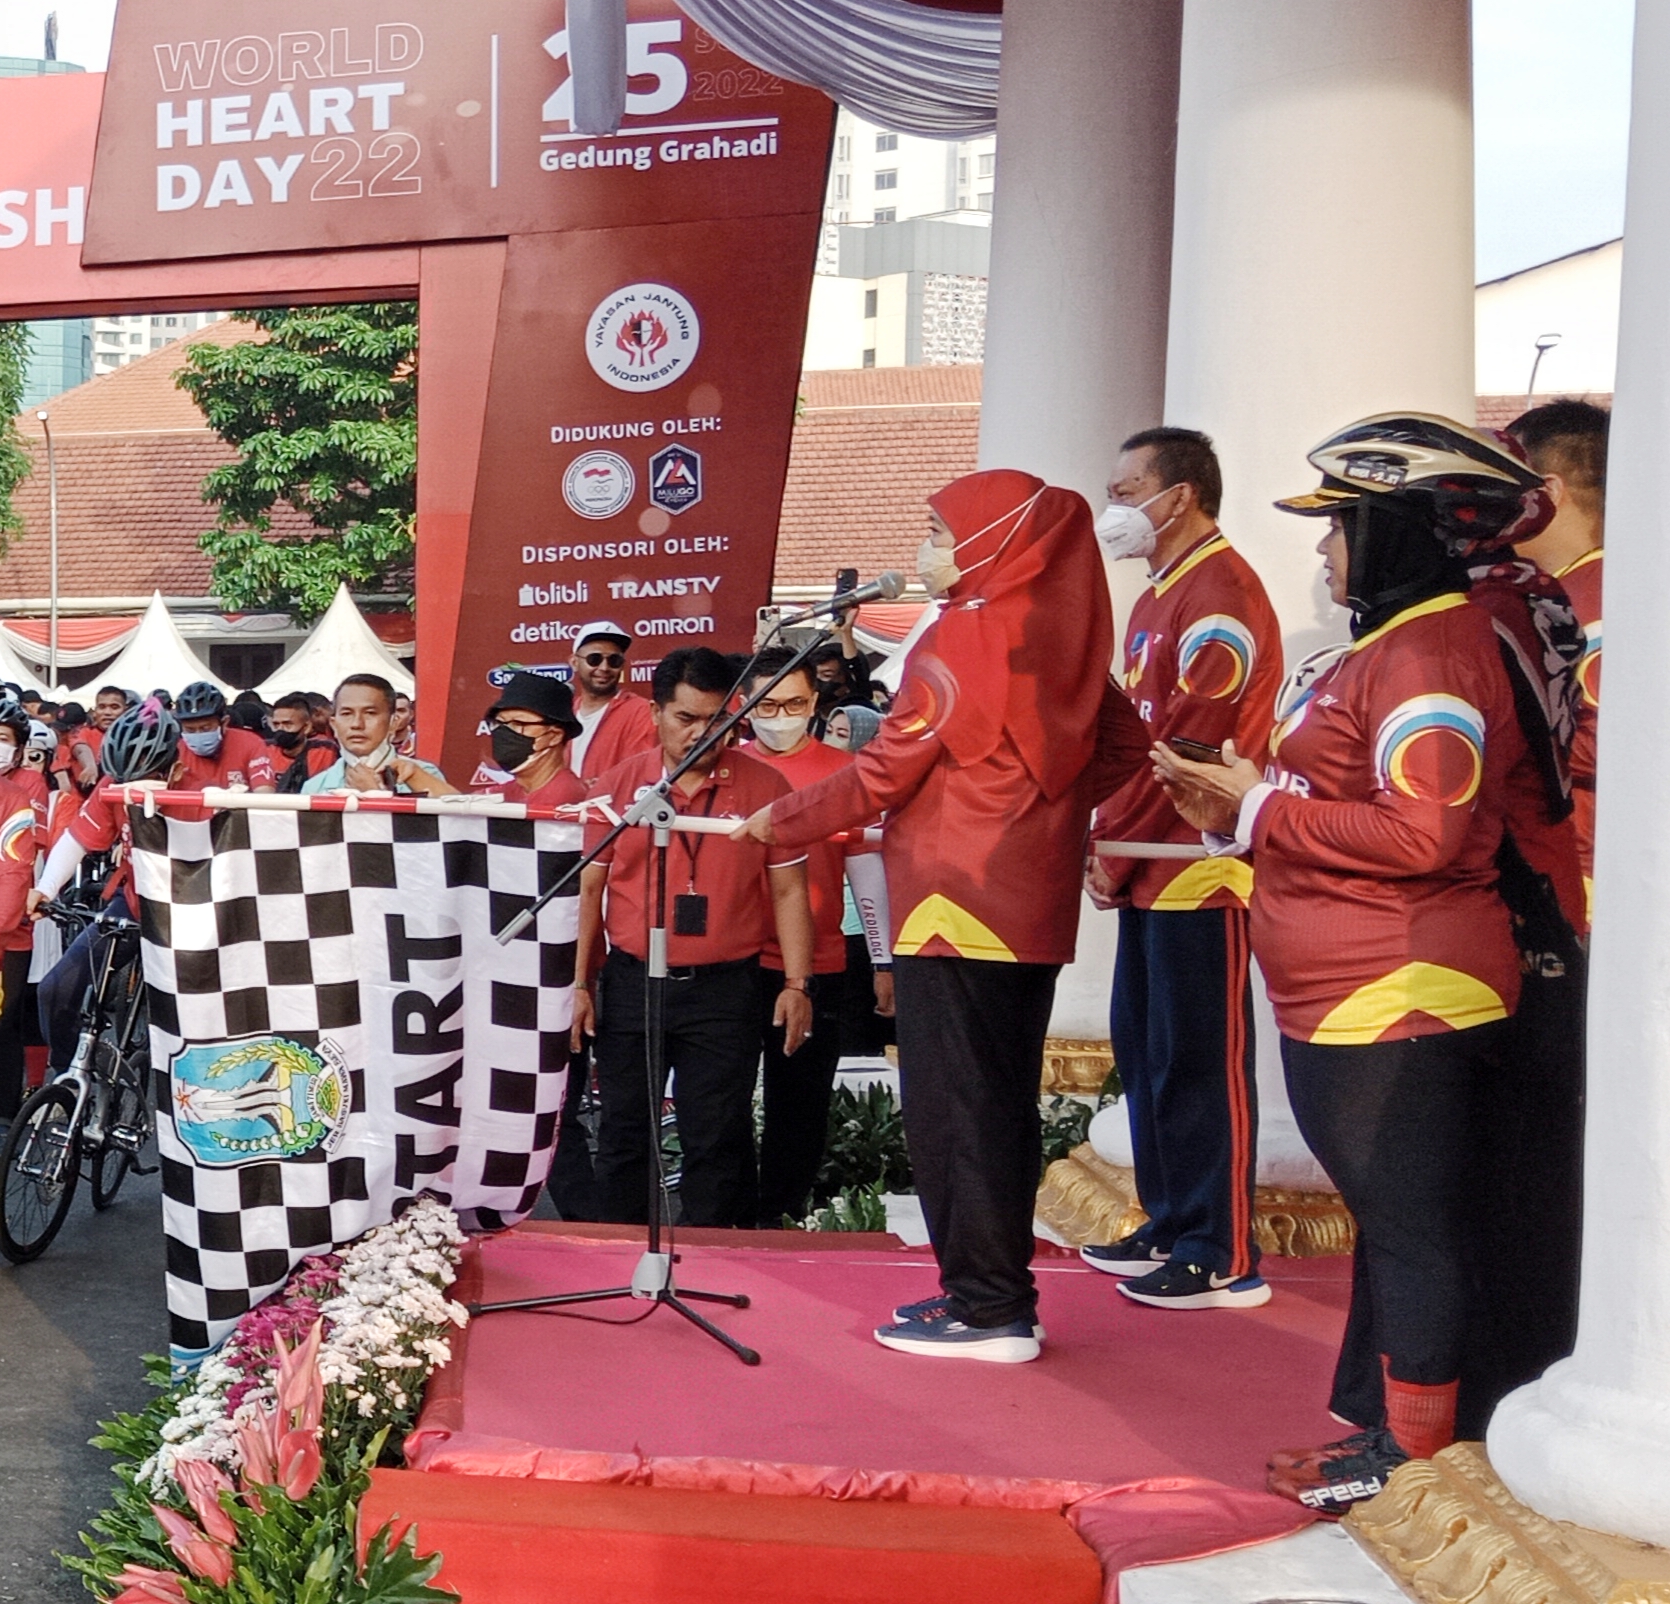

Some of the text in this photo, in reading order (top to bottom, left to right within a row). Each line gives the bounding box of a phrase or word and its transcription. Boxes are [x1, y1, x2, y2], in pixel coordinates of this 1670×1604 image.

[153, 22, 424, 92] WORLD
[156, 82, 405, 149] HEART
[156, 132, 422, 212] DAY 22
[539, 132, 779, 171] Gedung Grahadi
[595, 293, 690, 348] YAYASAN JANTUNG
[606, 357, 682, 383] INDONESIA
[550, 417, 722, 443] DIDUKUNG OLEH:
[521, 536, 729, 564] DISPONSORI OLEH:
[534, 580, 589, 605] blibli
[860, 897, 884, 958] CARDIOLOGY
